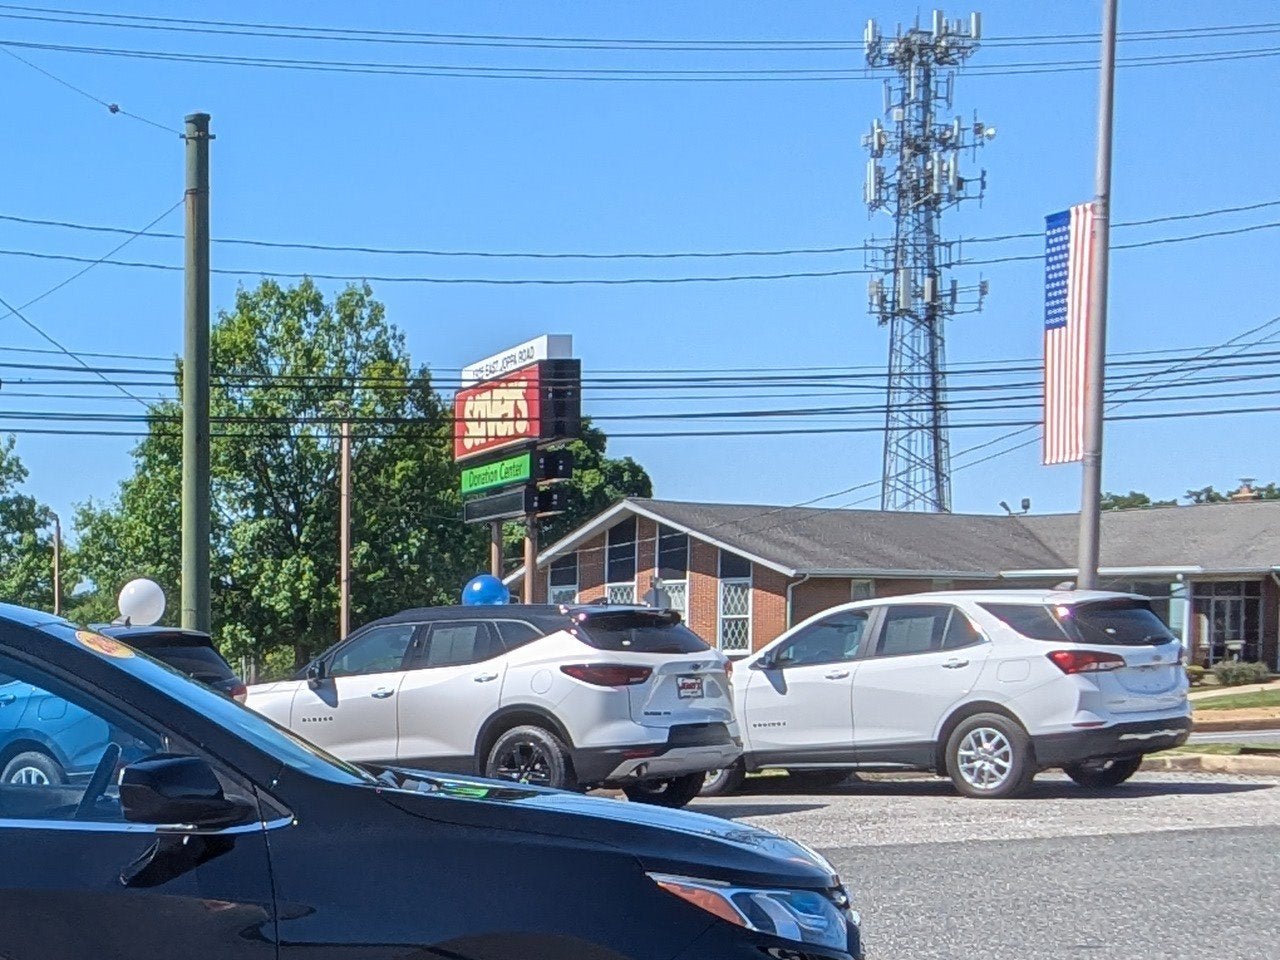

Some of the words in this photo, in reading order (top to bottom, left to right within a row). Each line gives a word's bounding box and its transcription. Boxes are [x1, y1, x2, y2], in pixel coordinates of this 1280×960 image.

[518, 346, 535, 362] ROAD
[469, 467, 498, 487] Donation
[500, 462, 522, 480] Center
